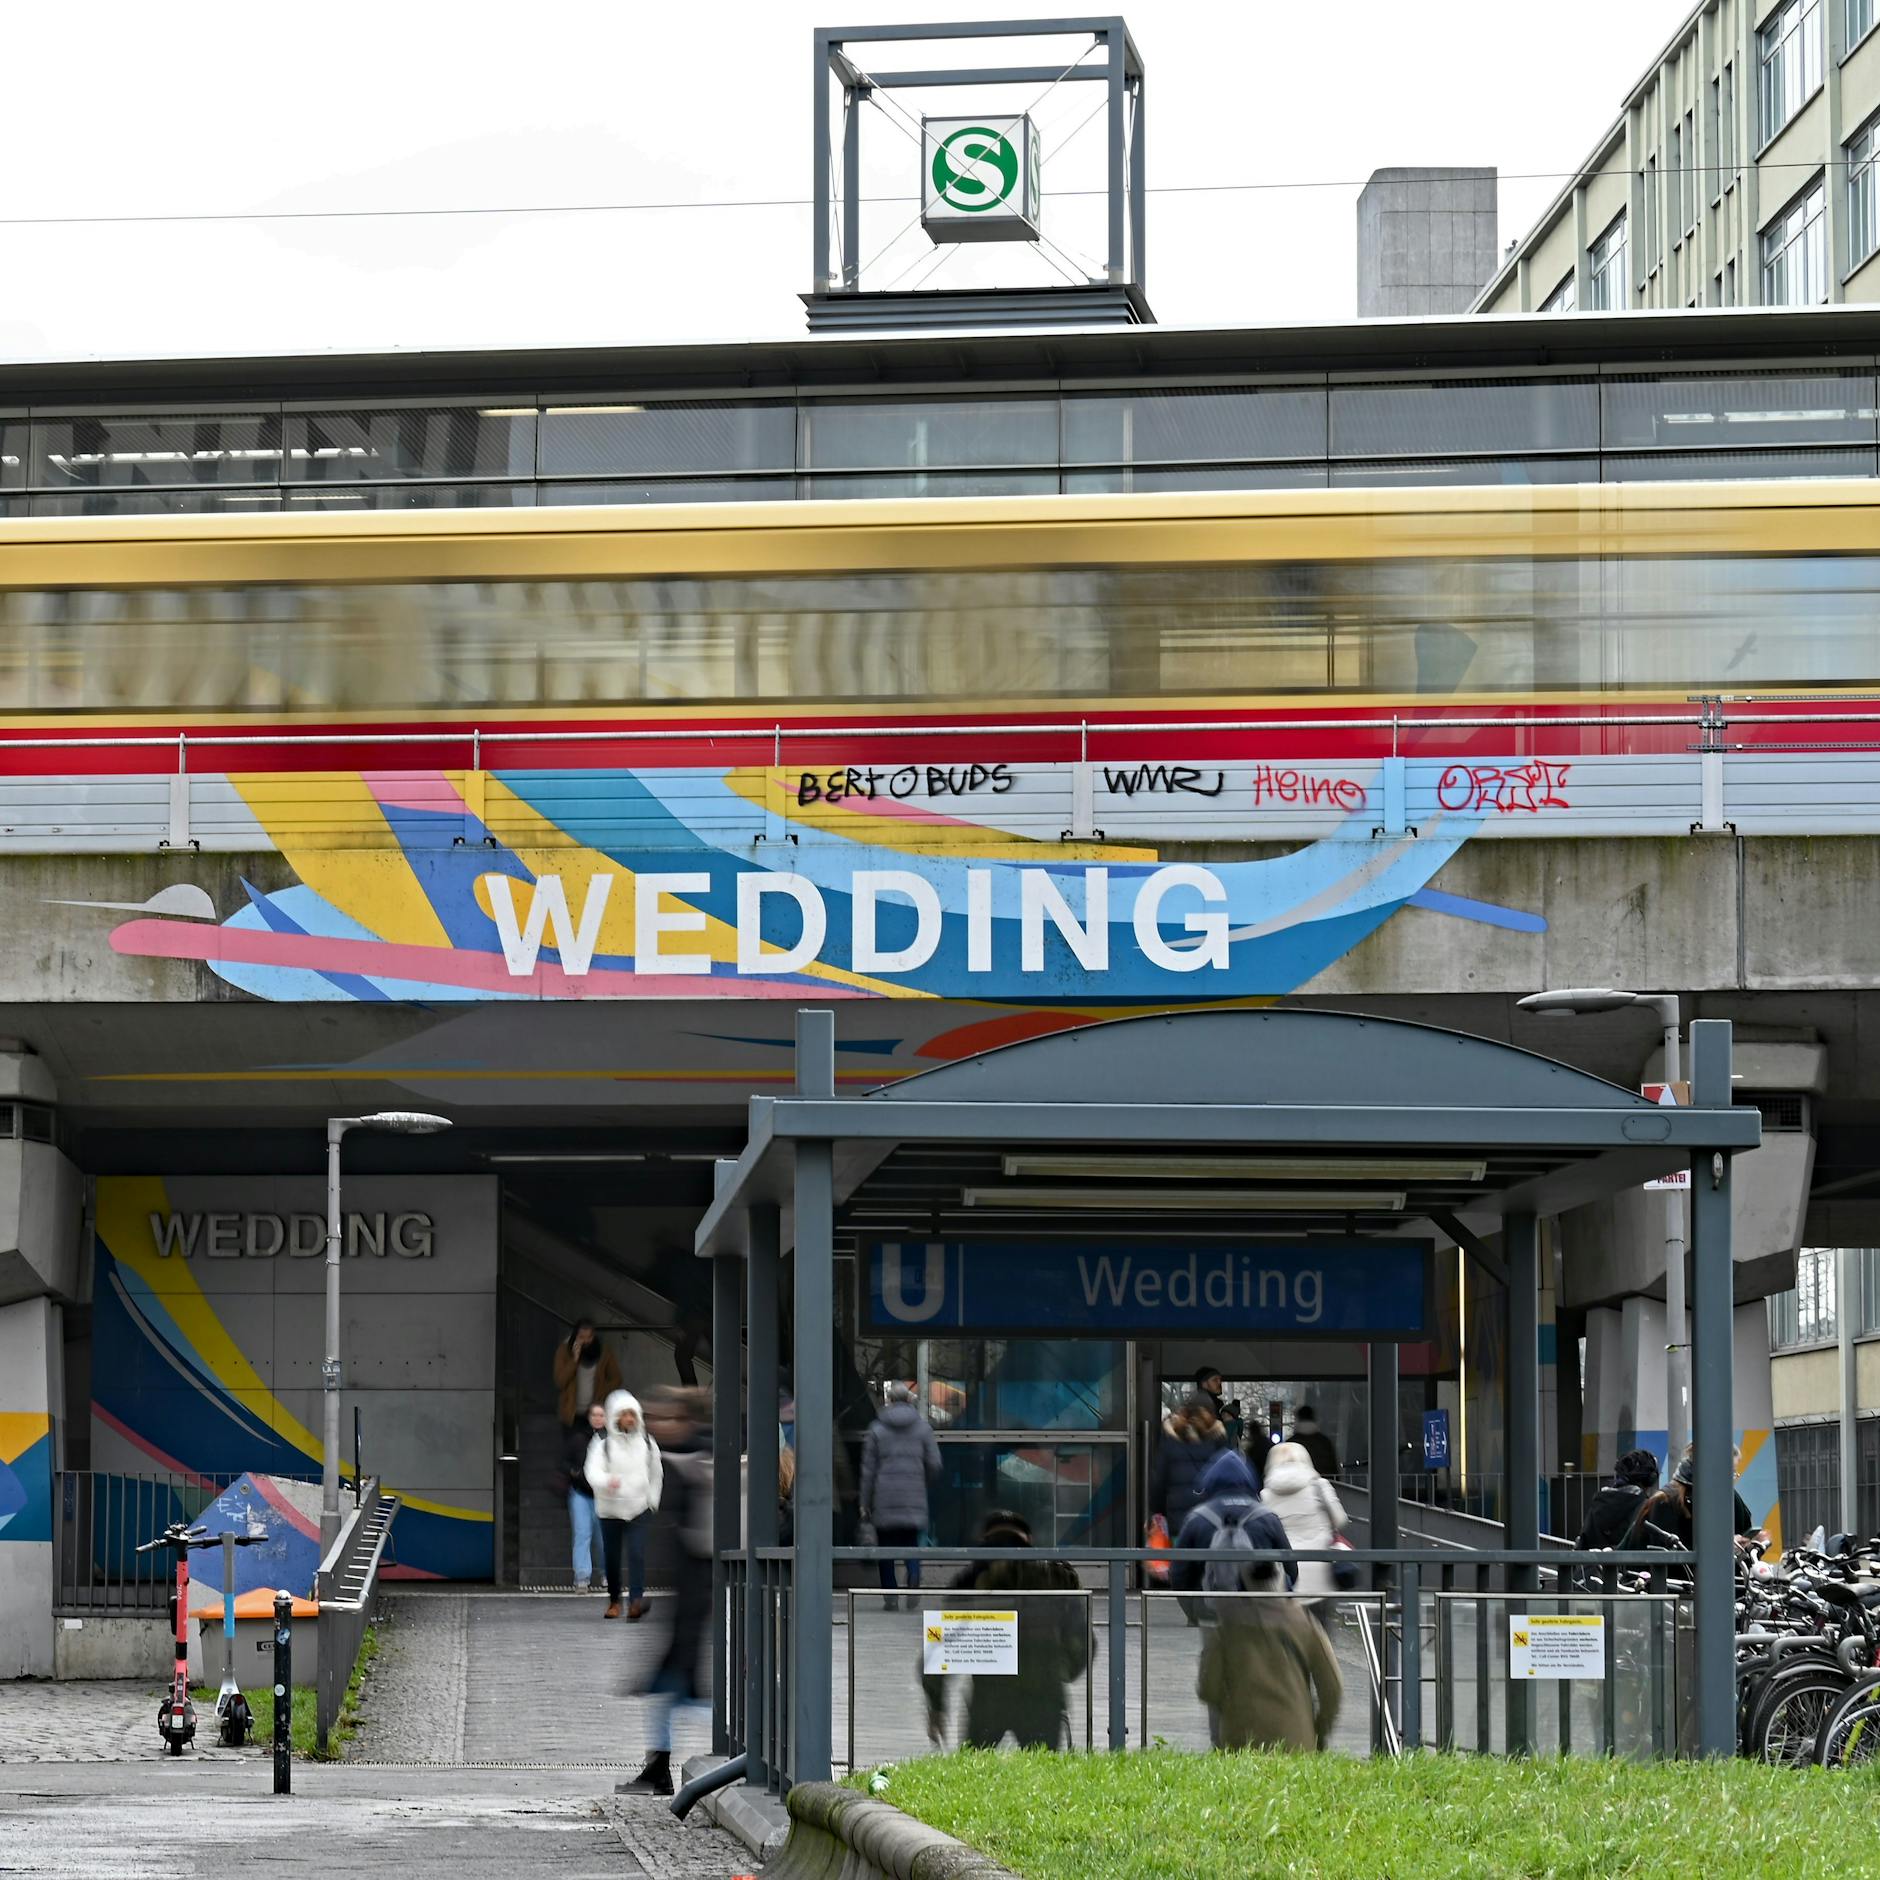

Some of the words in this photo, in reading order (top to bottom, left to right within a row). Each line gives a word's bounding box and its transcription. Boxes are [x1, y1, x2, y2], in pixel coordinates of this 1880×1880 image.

[485, 865, 1230, 977] WEDDING
[149, 1212, 433, 1258] WEDDNG
[881, 1243, 945, 1322] U
[1076, 1253, 1323, 1323] Wedding
